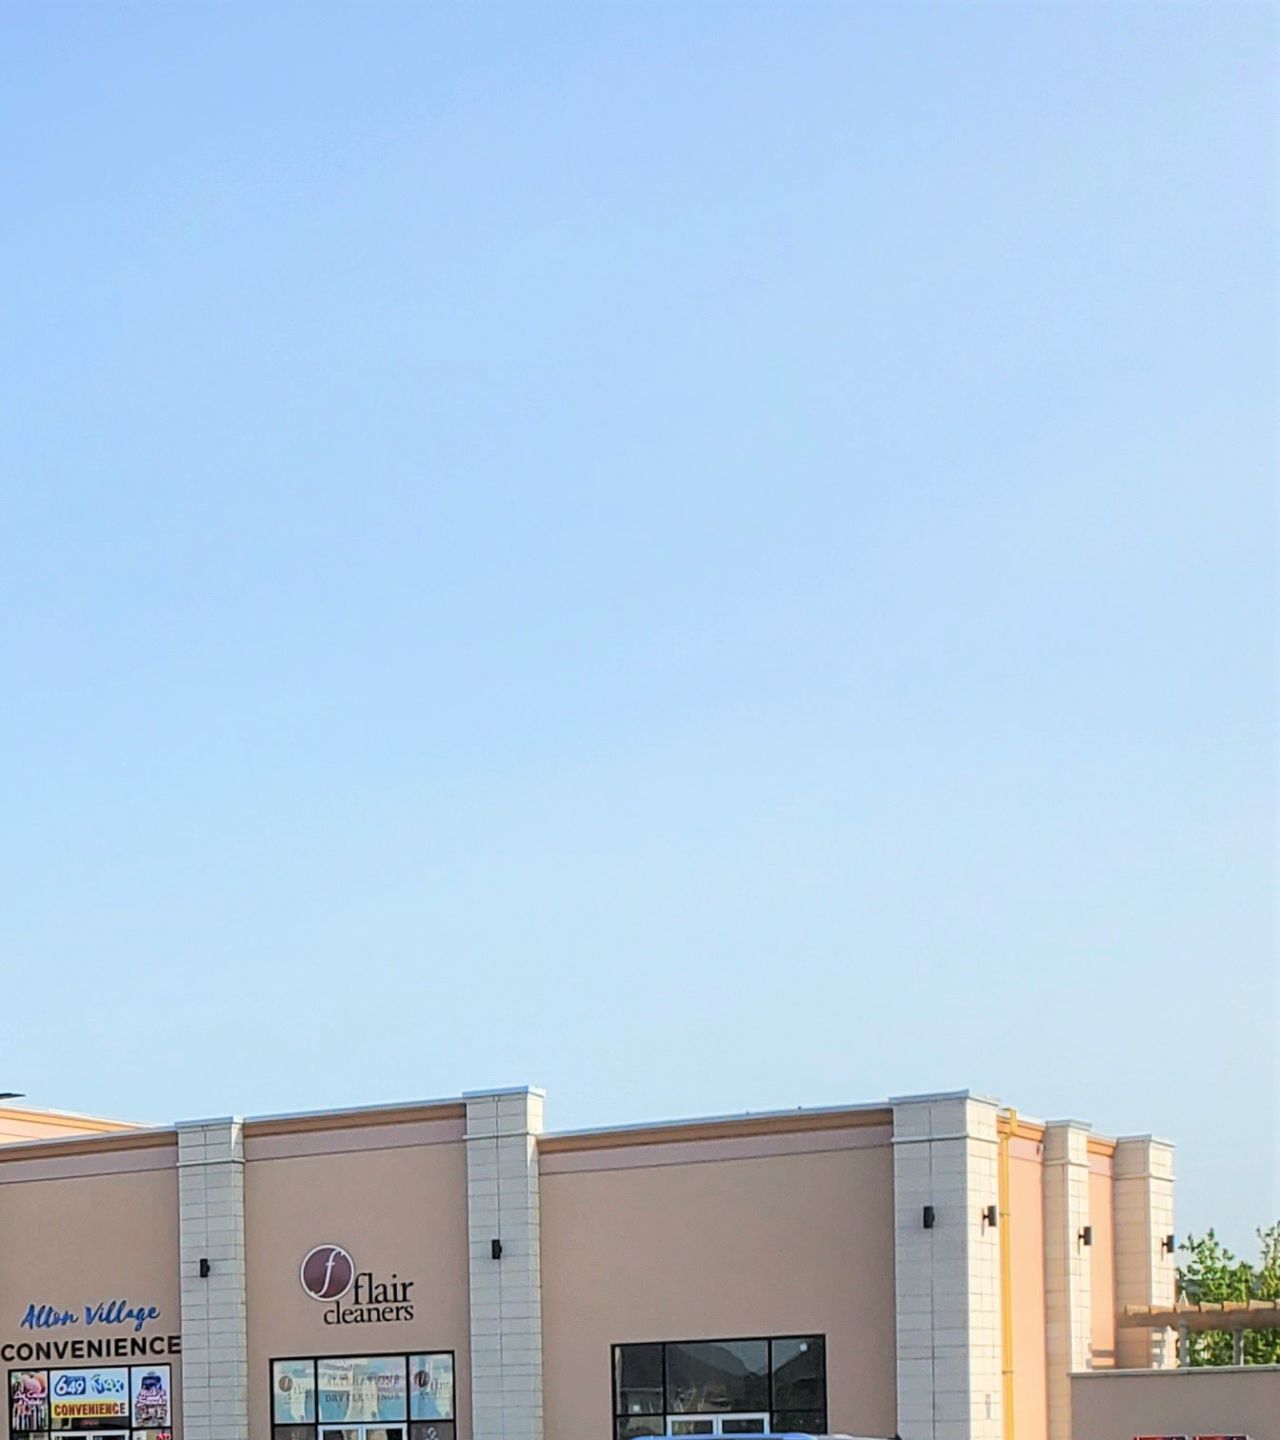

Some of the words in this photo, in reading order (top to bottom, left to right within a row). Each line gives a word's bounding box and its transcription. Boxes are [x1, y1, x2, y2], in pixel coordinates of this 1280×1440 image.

[353, 1272, 415, 1305] flair
[20, 1303, 79, 1330] Alton
[85, 1299, 161, 1332] Village
[323, 1301, 415, 1325] cleaners
[0, 1335, 182, 1362] CONVENIENCE
[54, 1402, 126, 1416] CONVENIENCE
